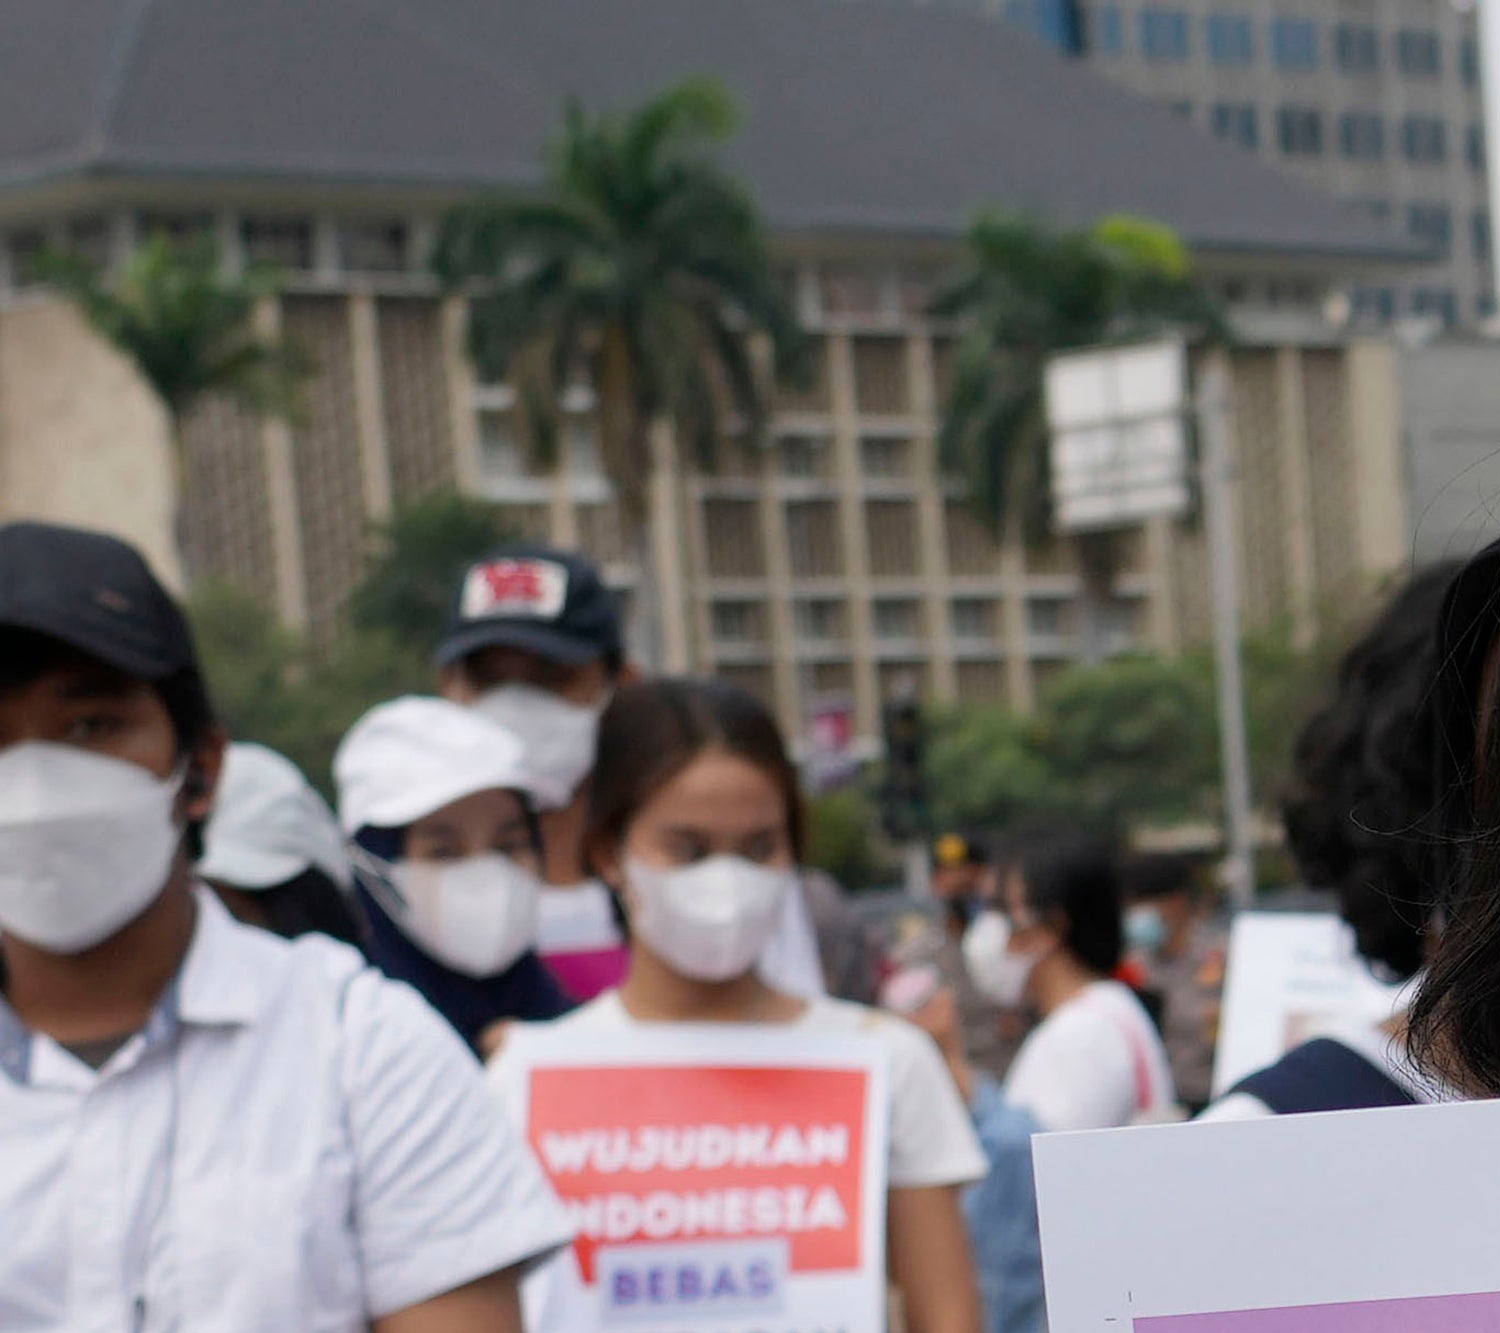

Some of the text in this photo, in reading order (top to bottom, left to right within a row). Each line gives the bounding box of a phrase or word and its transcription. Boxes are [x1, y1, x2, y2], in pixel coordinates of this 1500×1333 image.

[541, 1124, 849, 1173] WUJUDKAN
[570, 1186, 848, 1240] NDONESIA
[609, 1262, 776, 1305] BEBAS
